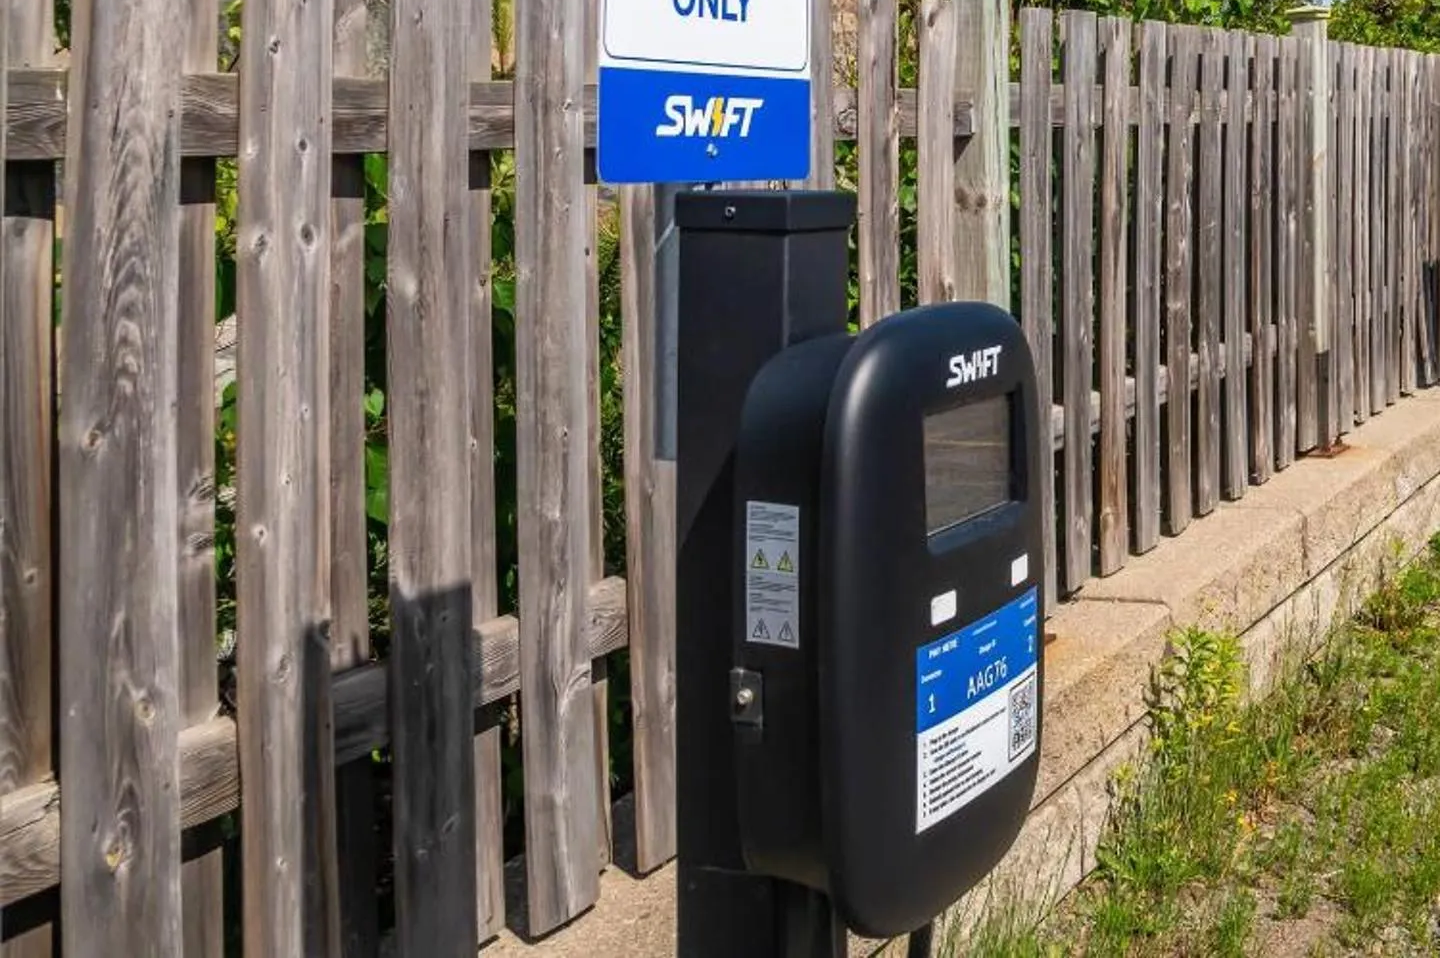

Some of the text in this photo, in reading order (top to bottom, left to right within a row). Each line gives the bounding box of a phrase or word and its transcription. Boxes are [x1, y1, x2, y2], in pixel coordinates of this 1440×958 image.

[656, 95, 764, 137] SWIFT
[946, 345, 1002, 388] SWIFT
[928, 693, 936, 713] 1
